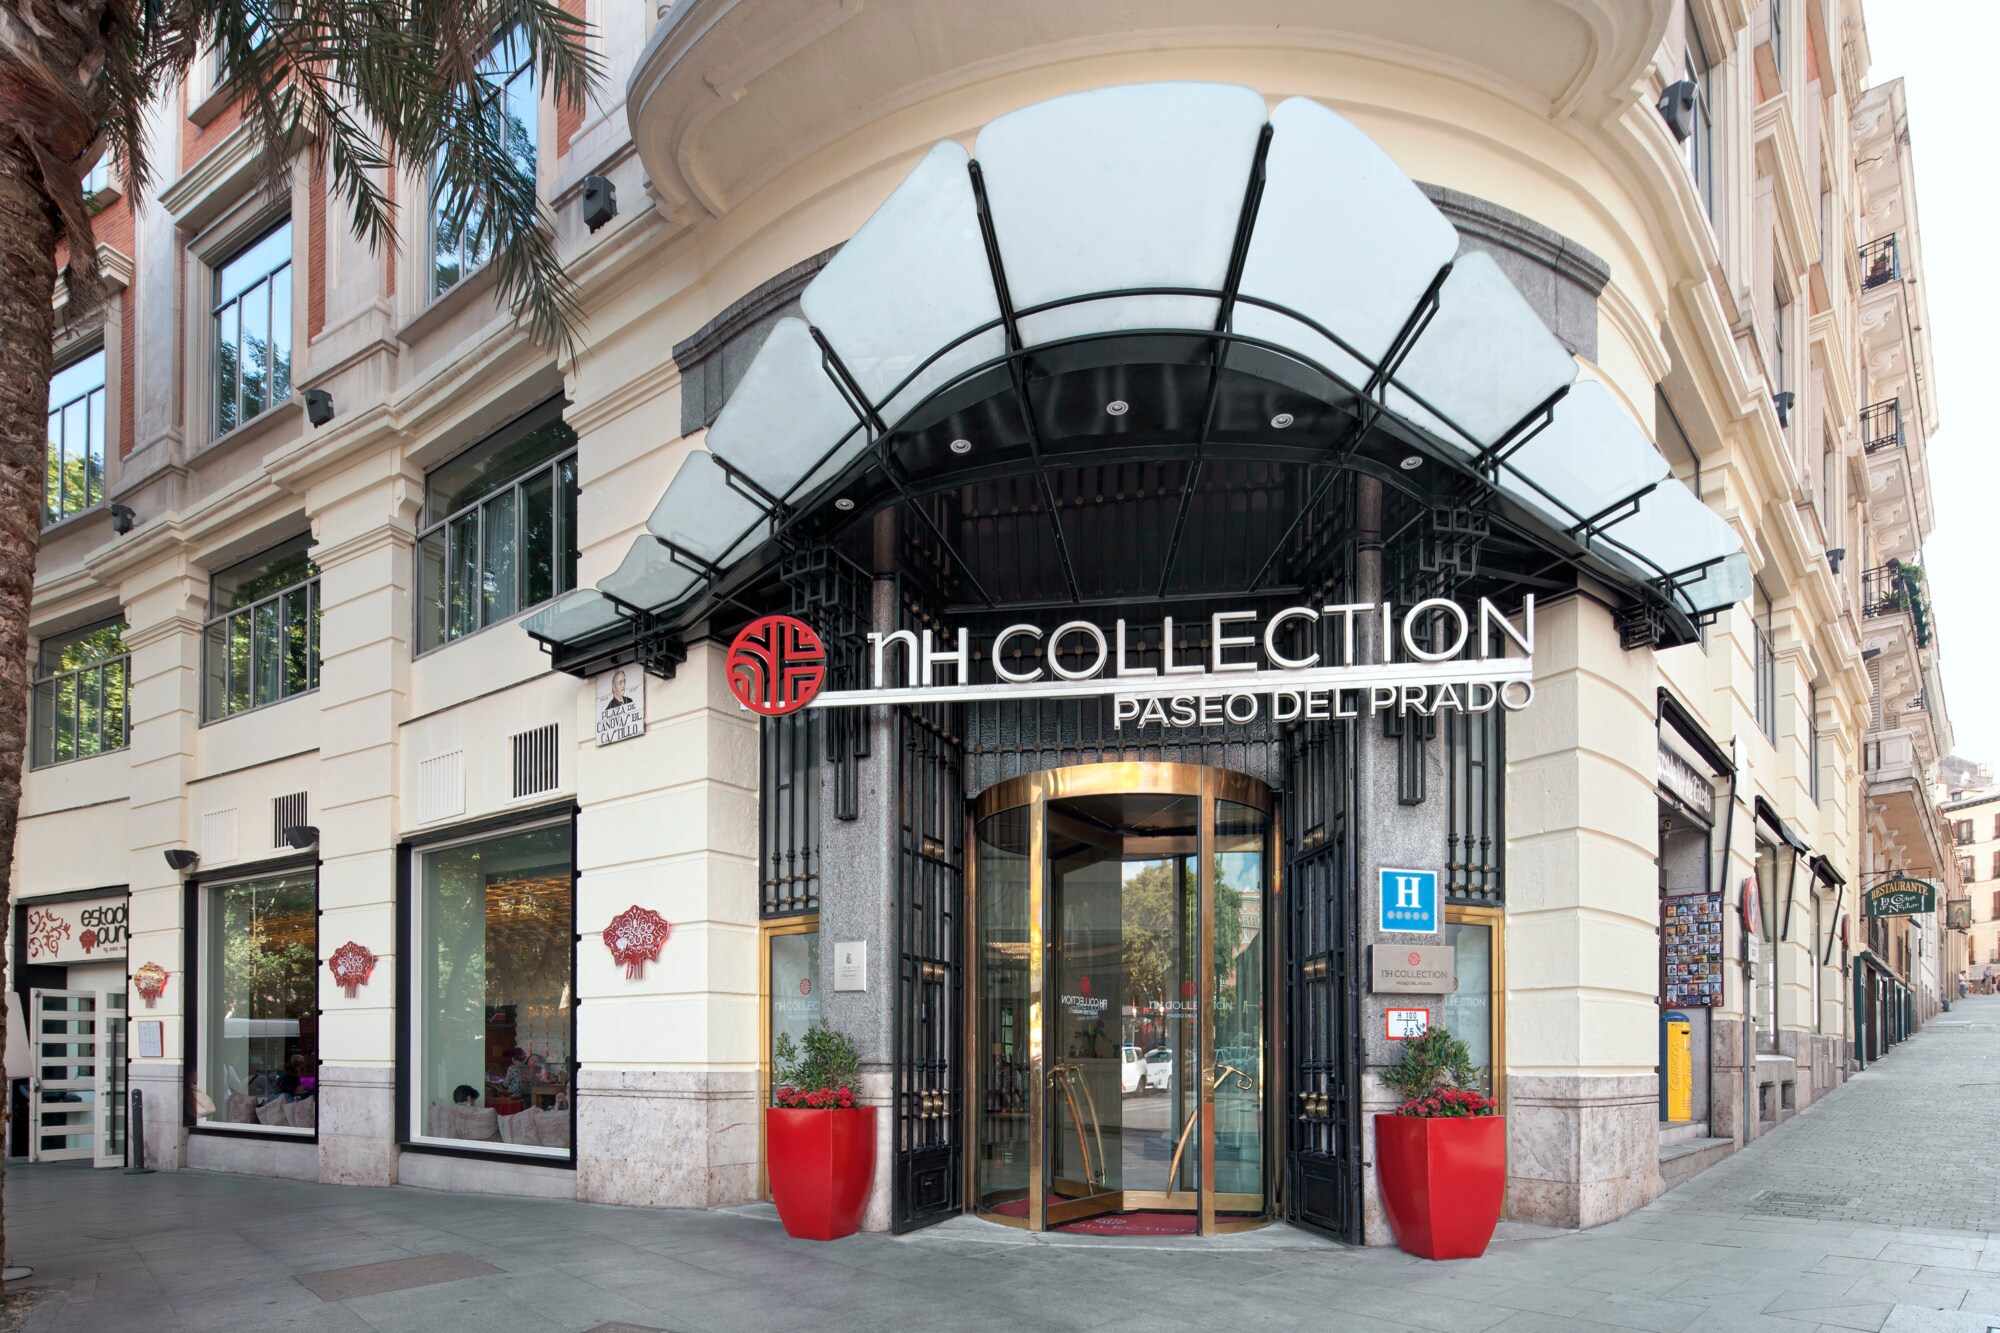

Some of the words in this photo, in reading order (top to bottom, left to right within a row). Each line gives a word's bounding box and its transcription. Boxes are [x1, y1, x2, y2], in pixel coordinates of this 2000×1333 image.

[867, 627, 969, 689] nH
[992, 593, 1535, 685] COLLECTION
[601, 705, 626, 721] PLAZA
[627, 703, 637, 711] DE
[1113, 691, 1259, 730] PASEO
[1272, 686, 1358, 723] DEL
[1369, 678, 1536, 719] PRADO
[600, 723, 638, 744] CASTILLO
[1395, 876, 1422, 909] H
[1871, 881, 1929, 900] RESTAURANTE
[81, 903, 128, 927] estad
[96, 925, 128, 948] pur
[1394, 970, 1448, 979] COLLECTION
[1397, 1011, 1402, 1019] H
